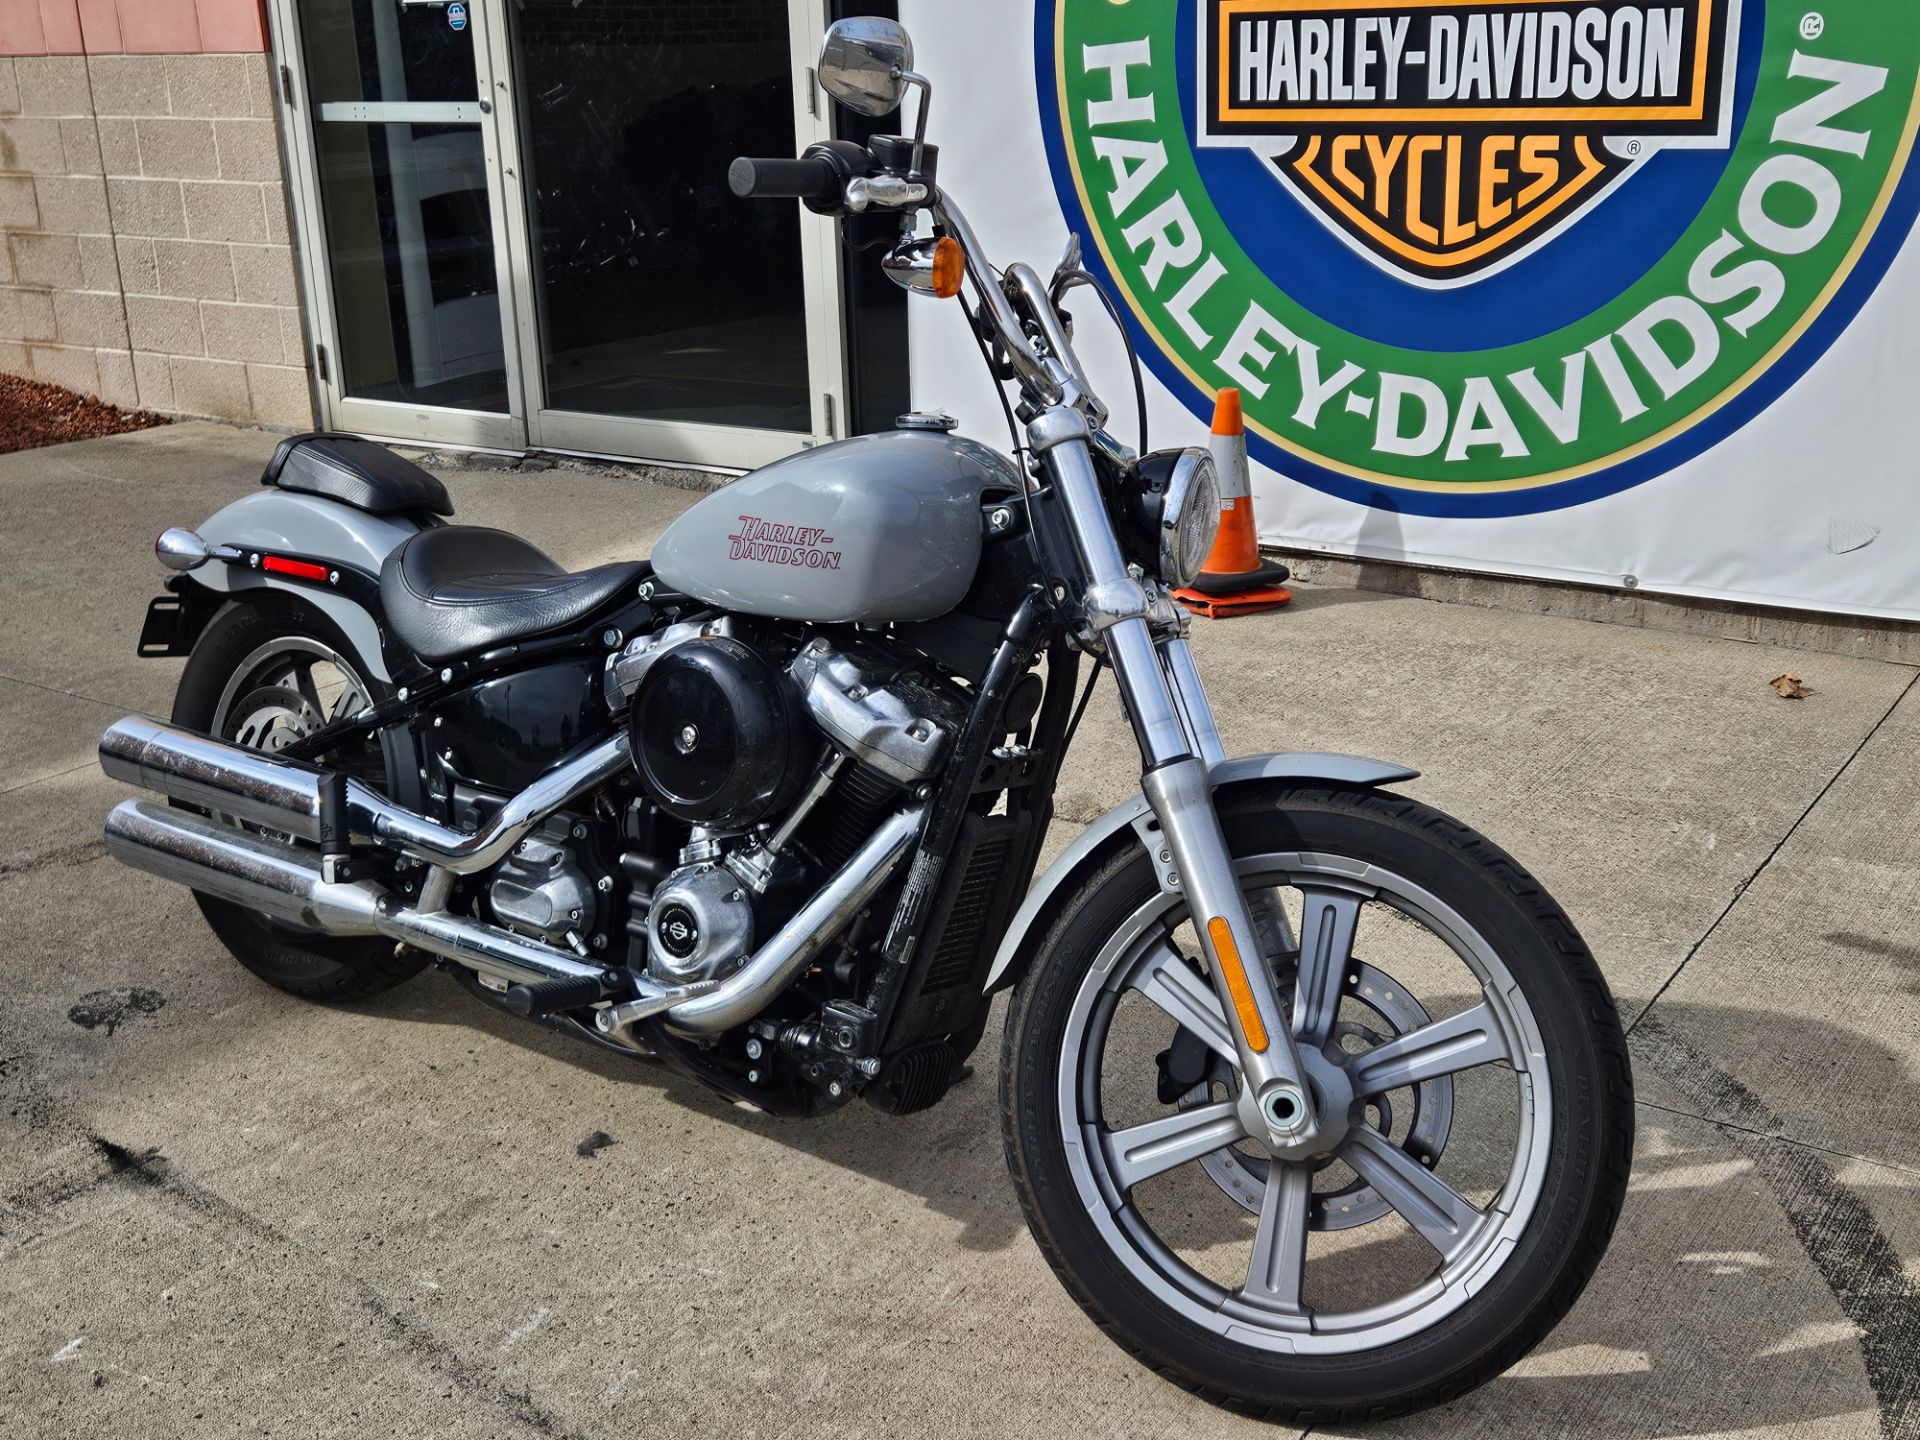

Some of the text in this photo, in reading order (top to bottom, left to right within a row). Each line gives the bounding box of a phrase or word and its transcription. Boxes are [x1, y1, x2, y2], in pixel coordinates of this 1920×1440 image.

[1238, 5, 1682, 102] HARLEY-DAVIDSON
[1330, 135, 1560, 246] CYCLES
[1083, 34, 1889, 462] HARLEY-DAVIDSON
[739, 515, 834, 546] HARLEY-
